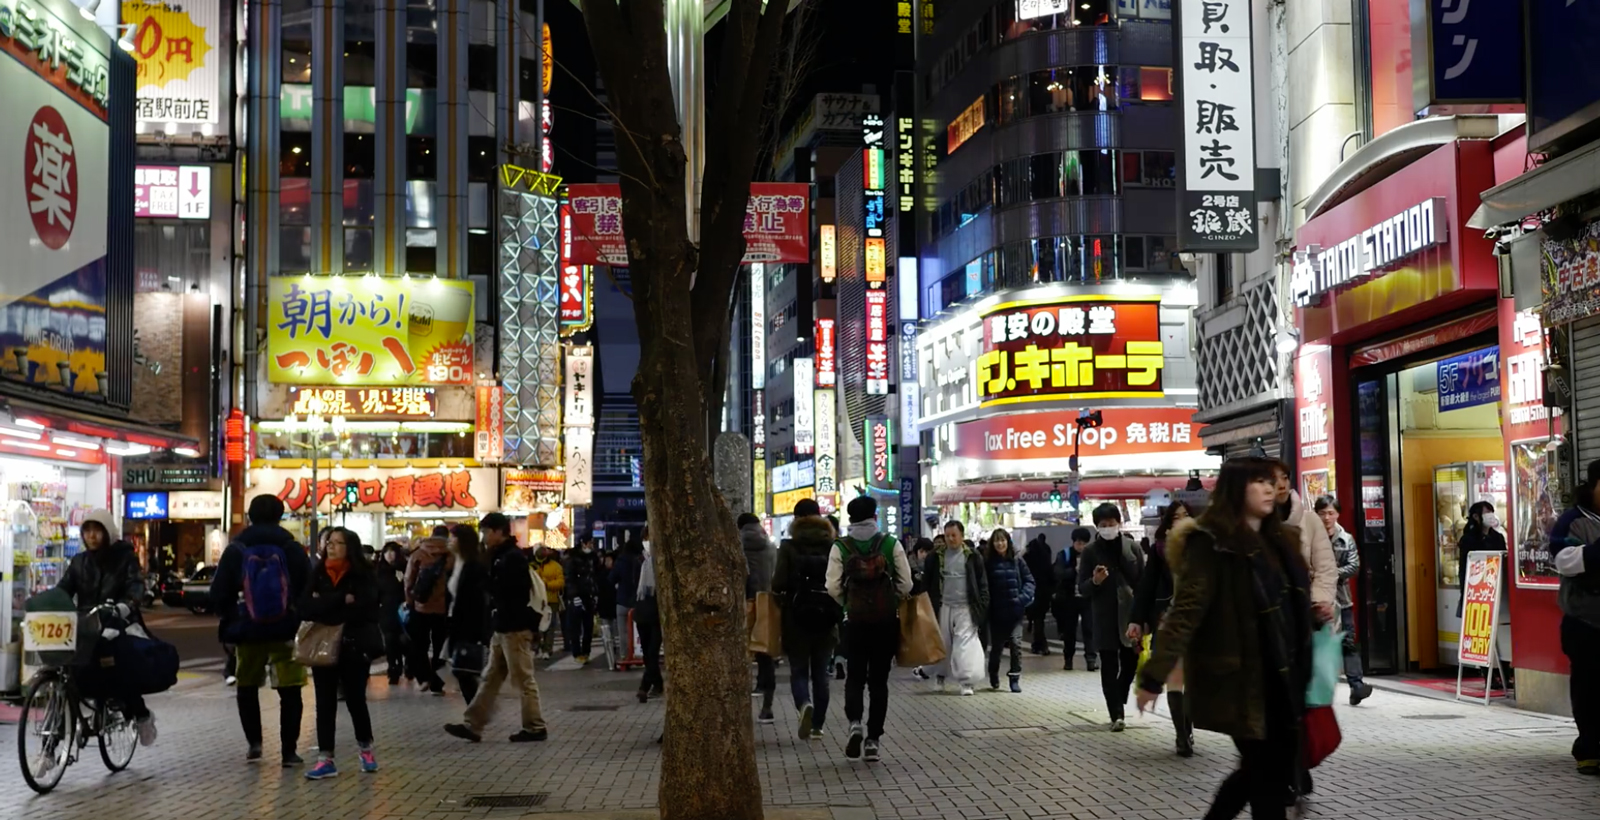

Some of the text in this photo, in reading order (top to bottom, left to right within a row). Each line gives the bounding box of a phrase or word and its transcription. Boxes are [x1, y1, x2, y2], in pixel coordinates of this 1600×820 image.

[20, 4, 109, 106] ミネドラッグ
[31, 121, 73, 230] 薬
[185, 202, 204, 213] 1F
[1202, 195, 1240, 207] 2号店
[1317, 198, 1434, 291] TAITO STATION
[278, 284, 404, 339] 朝から!
[24, 327, 48, 346] MINE
[275, 337, 416, 376] つぼ八
[432, 352, 470, 366] 生ビール
[1440, 362, 1458, 394] 5F
[1507, 350, 1543, 405] GAM
[984, 422, 1192, 451] Tax Free Shop 免税店
[1300, 402, 1328, 444] GAME
[873, 423, 888, 481] カラオケ
[902, 481, 913, 524] カラオケ
[1020, 492, 1041, 500] Don
[40, 622, 72, 638] 1267
[1471, 636, 1491, 655] DAY
